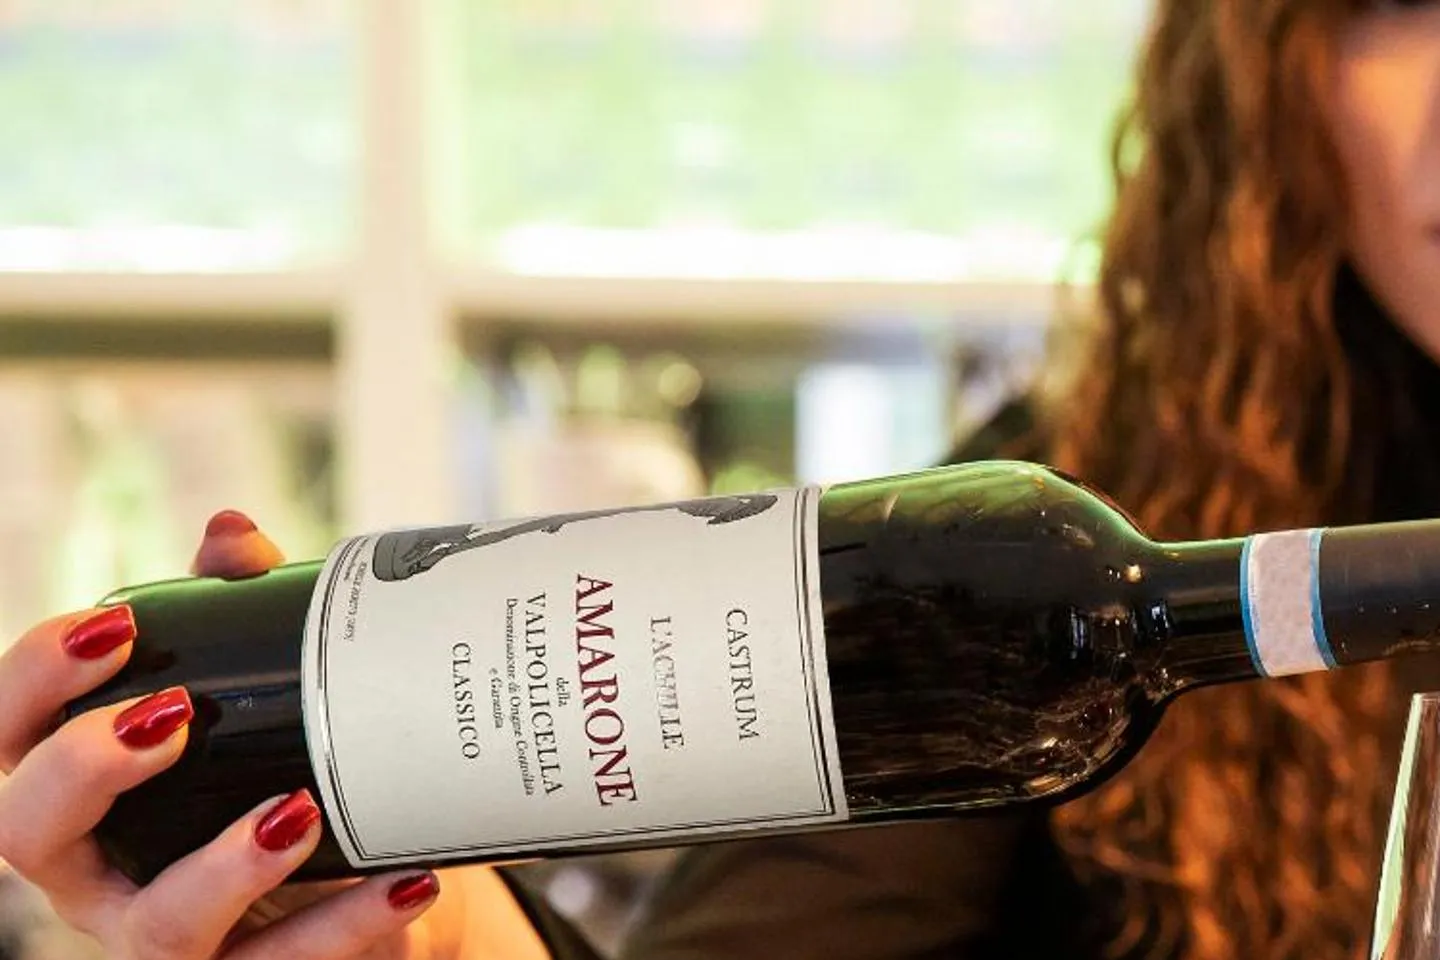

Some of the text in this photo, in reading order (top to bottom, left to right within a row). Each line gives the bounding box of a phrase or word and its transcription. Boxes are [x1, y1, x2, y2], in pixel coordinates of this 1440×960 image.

[451, 642, 481, 760] CLASSICO
[525, 592, 564, 795] VALPOLICELLA
[556, 677, 570, 707] della
[575, 573, 638, 806] AMARONE
[725, 608, 760, 740] CASTRUM
